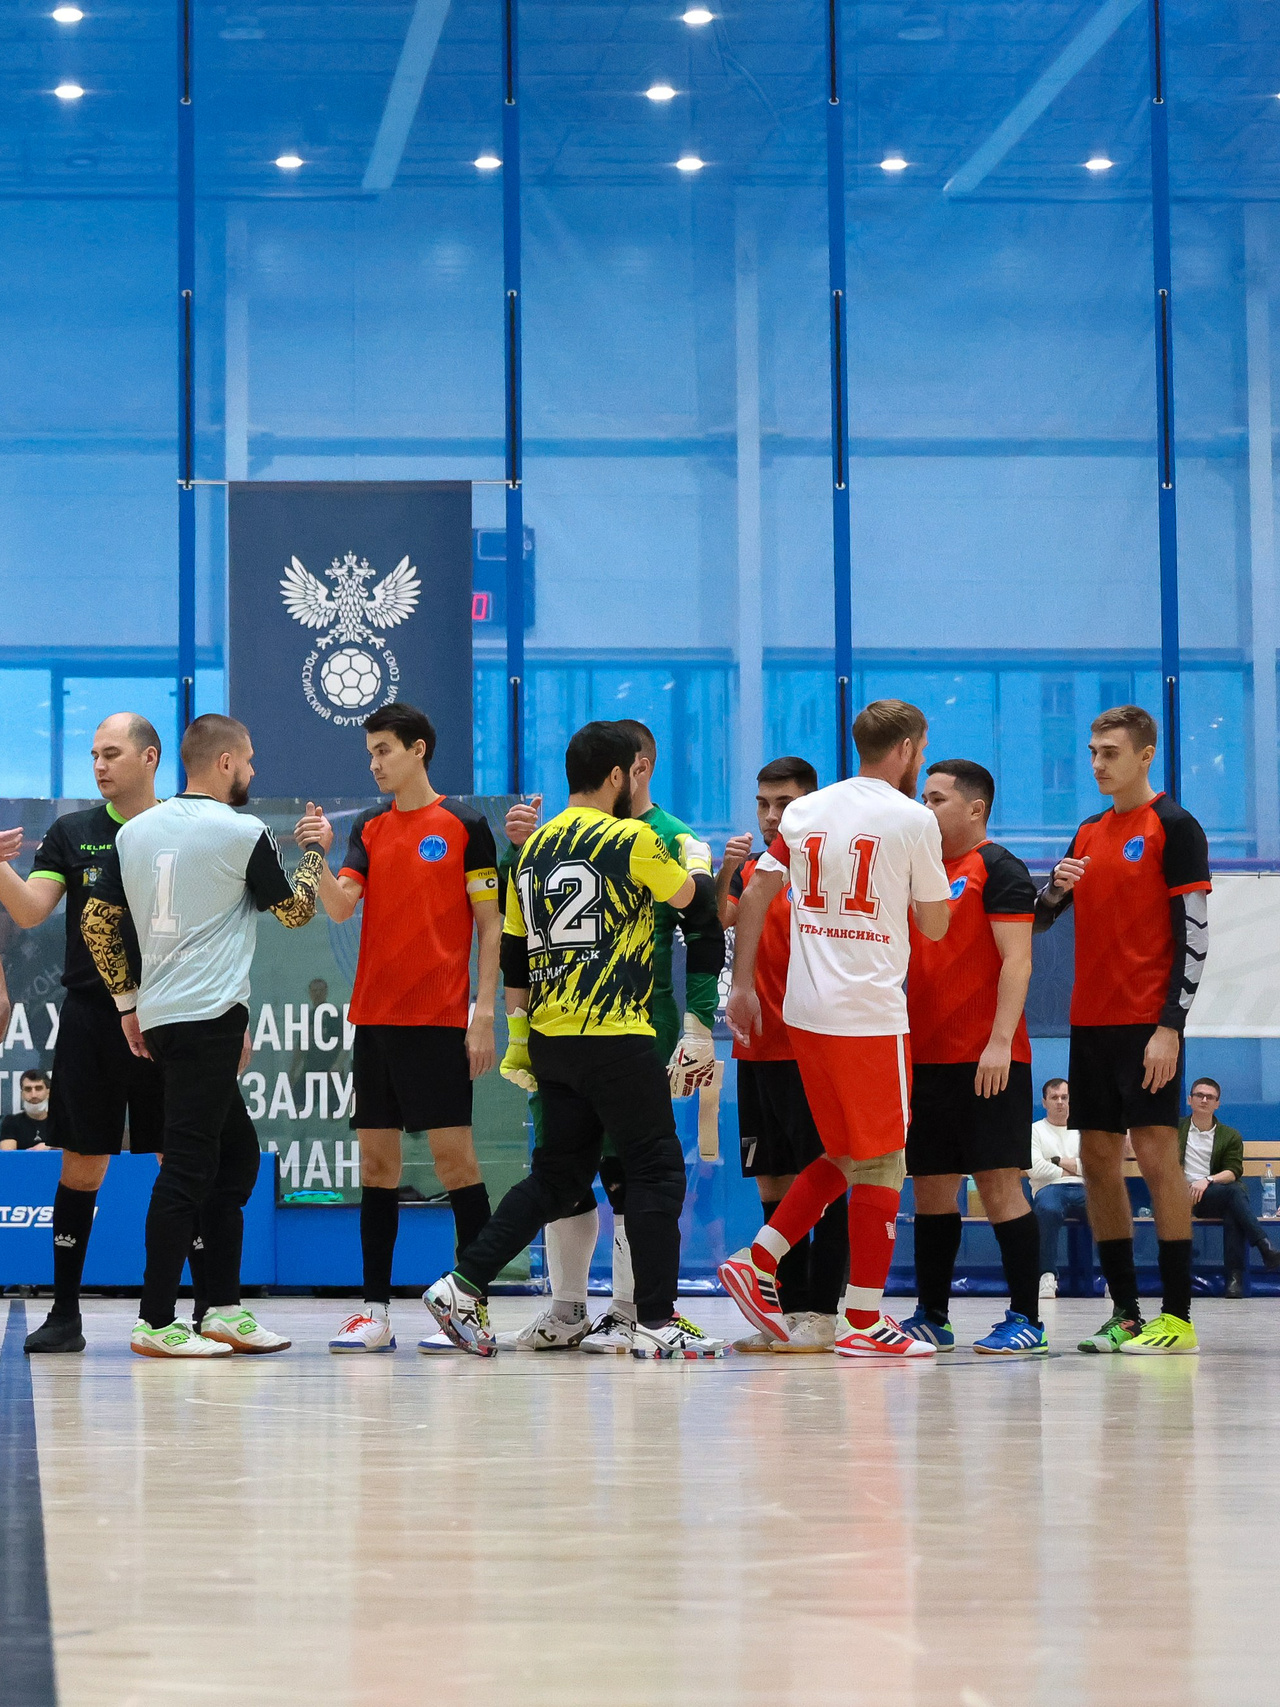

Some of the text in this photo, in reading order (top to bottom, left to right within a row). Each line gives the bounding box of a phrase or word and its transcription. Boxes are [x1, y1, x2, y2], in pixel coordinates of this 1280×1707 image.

[302, 650, 332, 720] РОССИЙСКИЙ
[382, 649, 400, 682] СОЮЗ
[150, 849, 182, 938] 1
[485, 878, 496, 889] C
[798, 832, 880, 920] 11
[518, 859, 602, 956] 12
[799, 923, 891, 945] ТЫ-МАНСИЙСК
[237, 1071, 354, 1119] ЗАЛУ
[742, 1137, 757, 1167] 7
